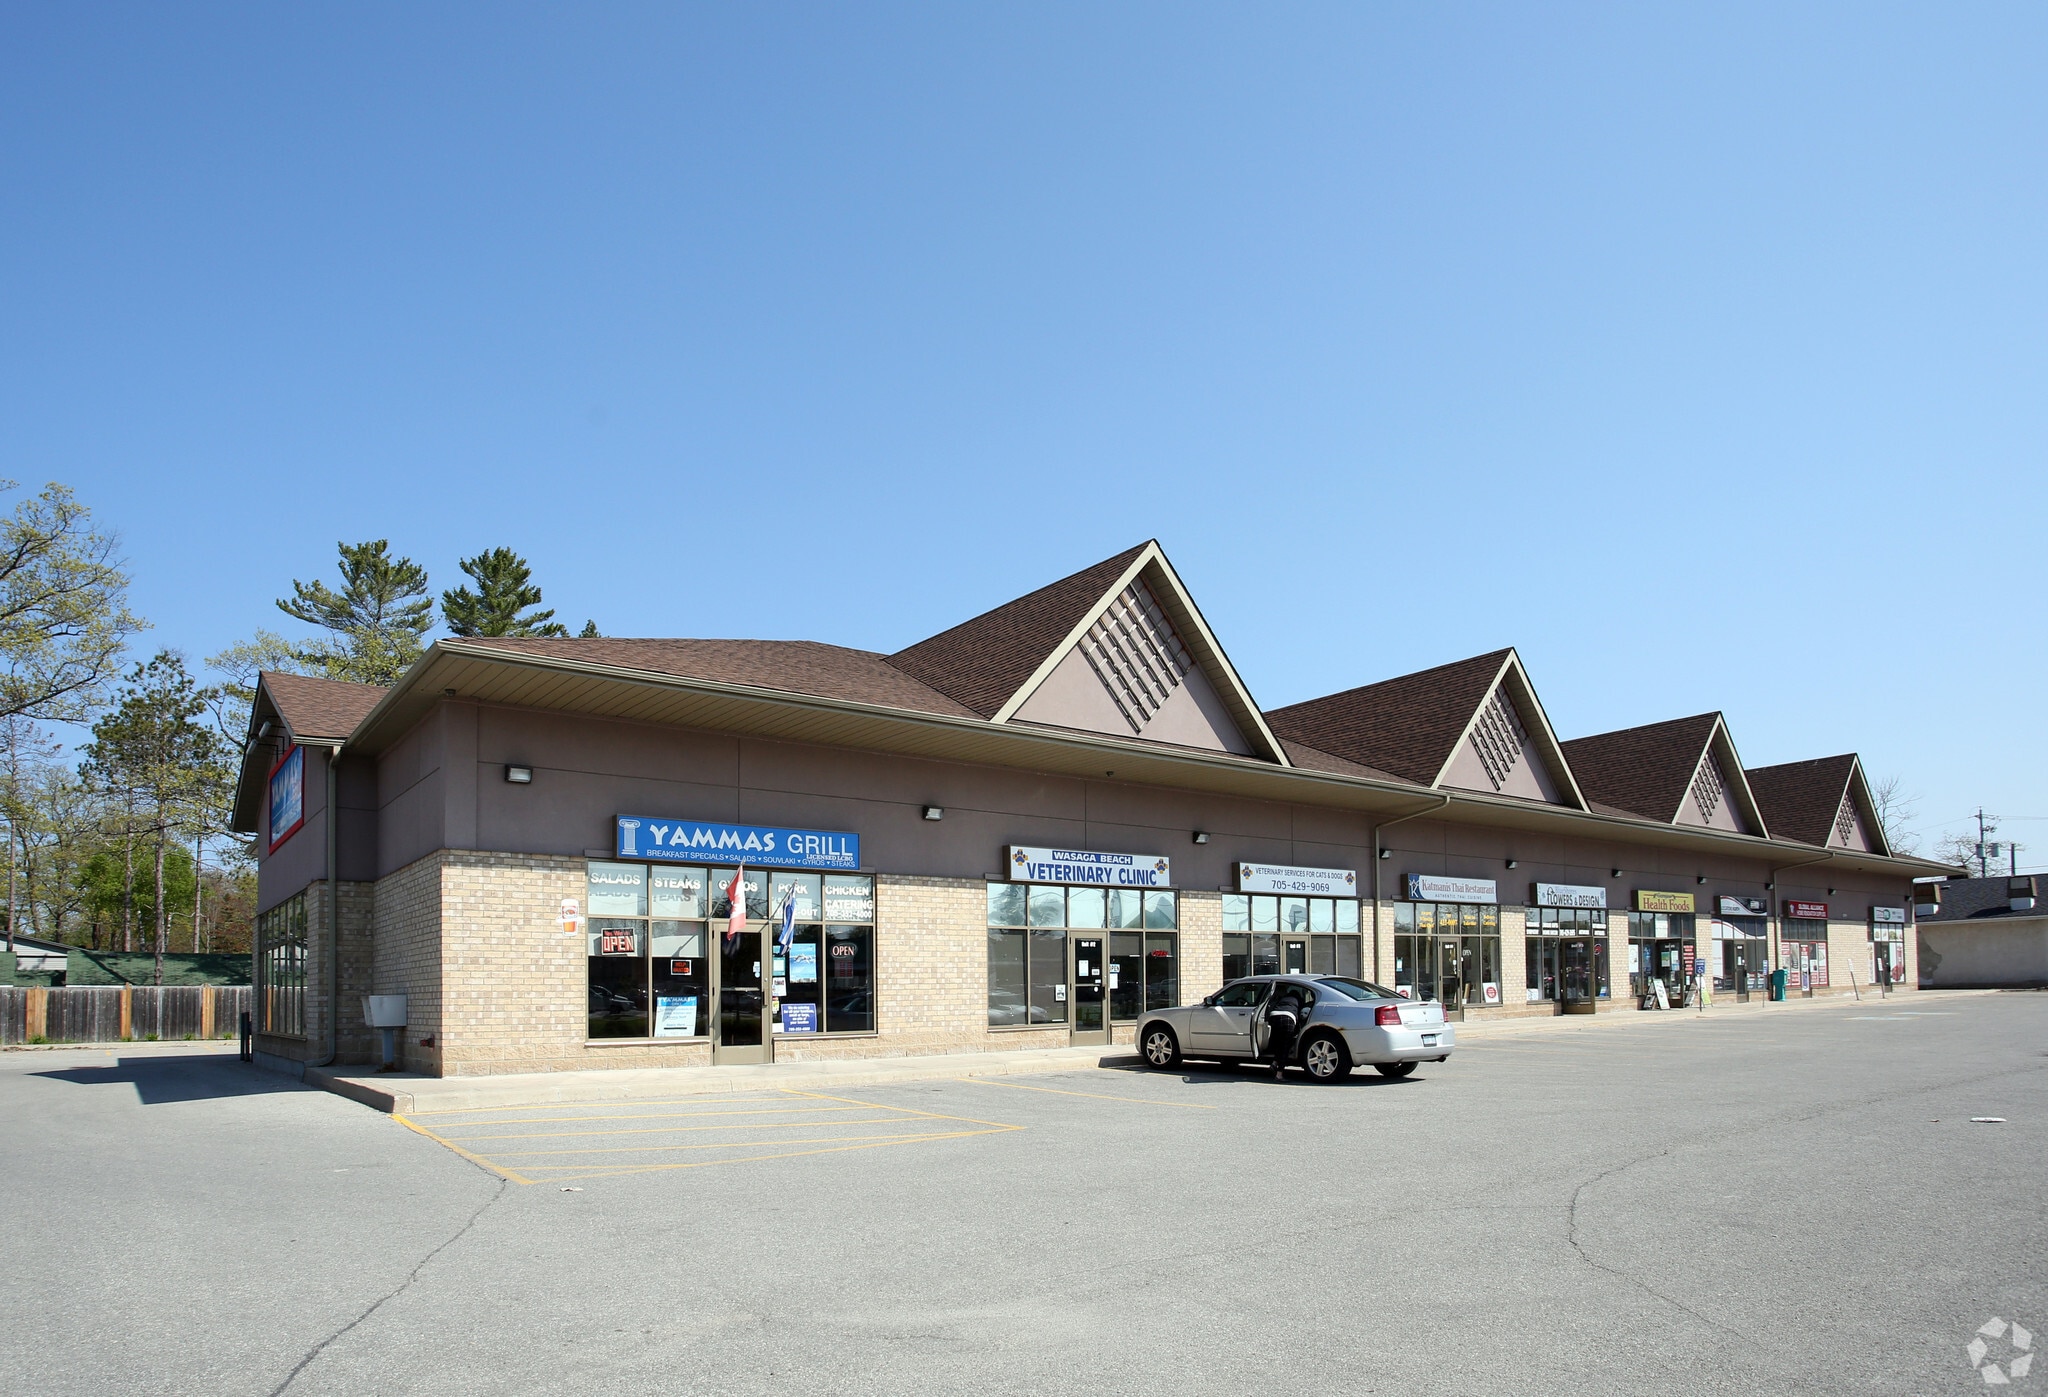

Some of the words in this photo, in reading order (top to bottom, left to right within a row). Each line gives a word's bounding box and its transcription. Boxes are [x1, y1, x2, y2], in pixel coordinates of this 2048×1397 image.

[649, 824, 776, 852] YAMMAS
[787, 834, 853, 856] GRILL
[646, 849, 689, 859] BREAKFAST
[690, 852, 724, 861] SPECIALS
[729, 854, 756, 863] SALADS
[763, 856, 796, 865] SOUVLAKI
[802, 858, 825, 866] GYROS
[831, 860, 856, 868] STEAKS
[806, 853, 836, 861] LICENSED
[1053, 851, 1097, 862] WASAGA
[1101, 853, 1131, 864] BEACH
[590, 872, 641, 885] SALADS
[1026, 862, 1112, 882] VETERINARY
[1118, 868, 1157, 886] CLINIC
[1255, 867, 1284, 876] VETERINARY
[1284, 868, 1306, 878] SERVICES
[1316, 871, 1327, 879] CATS
[654, 877, 701, 890] STEAKS
[718, 880, 758, 892] GOS
[777, 882, 808, 895] PORK
[1271, 880, 1330, 892] 705-429-9069
[1452, 882, 1464, 892] Thai
[1465, 884, 1495, 895] Restaurant
[825, 885, 869, 896] CHICKEN
[825, 899, 873, 910] CATERING
[1574, 896, 1578, 906] &
[1579, 895, 1600, 907] DESIGN
[1643, 897, 1668, 910] Health
[1669, 899, 1690, 911] Foods
[603, 936, 634, 952] OPEN
[832, 945, 855, 956] OPEN
